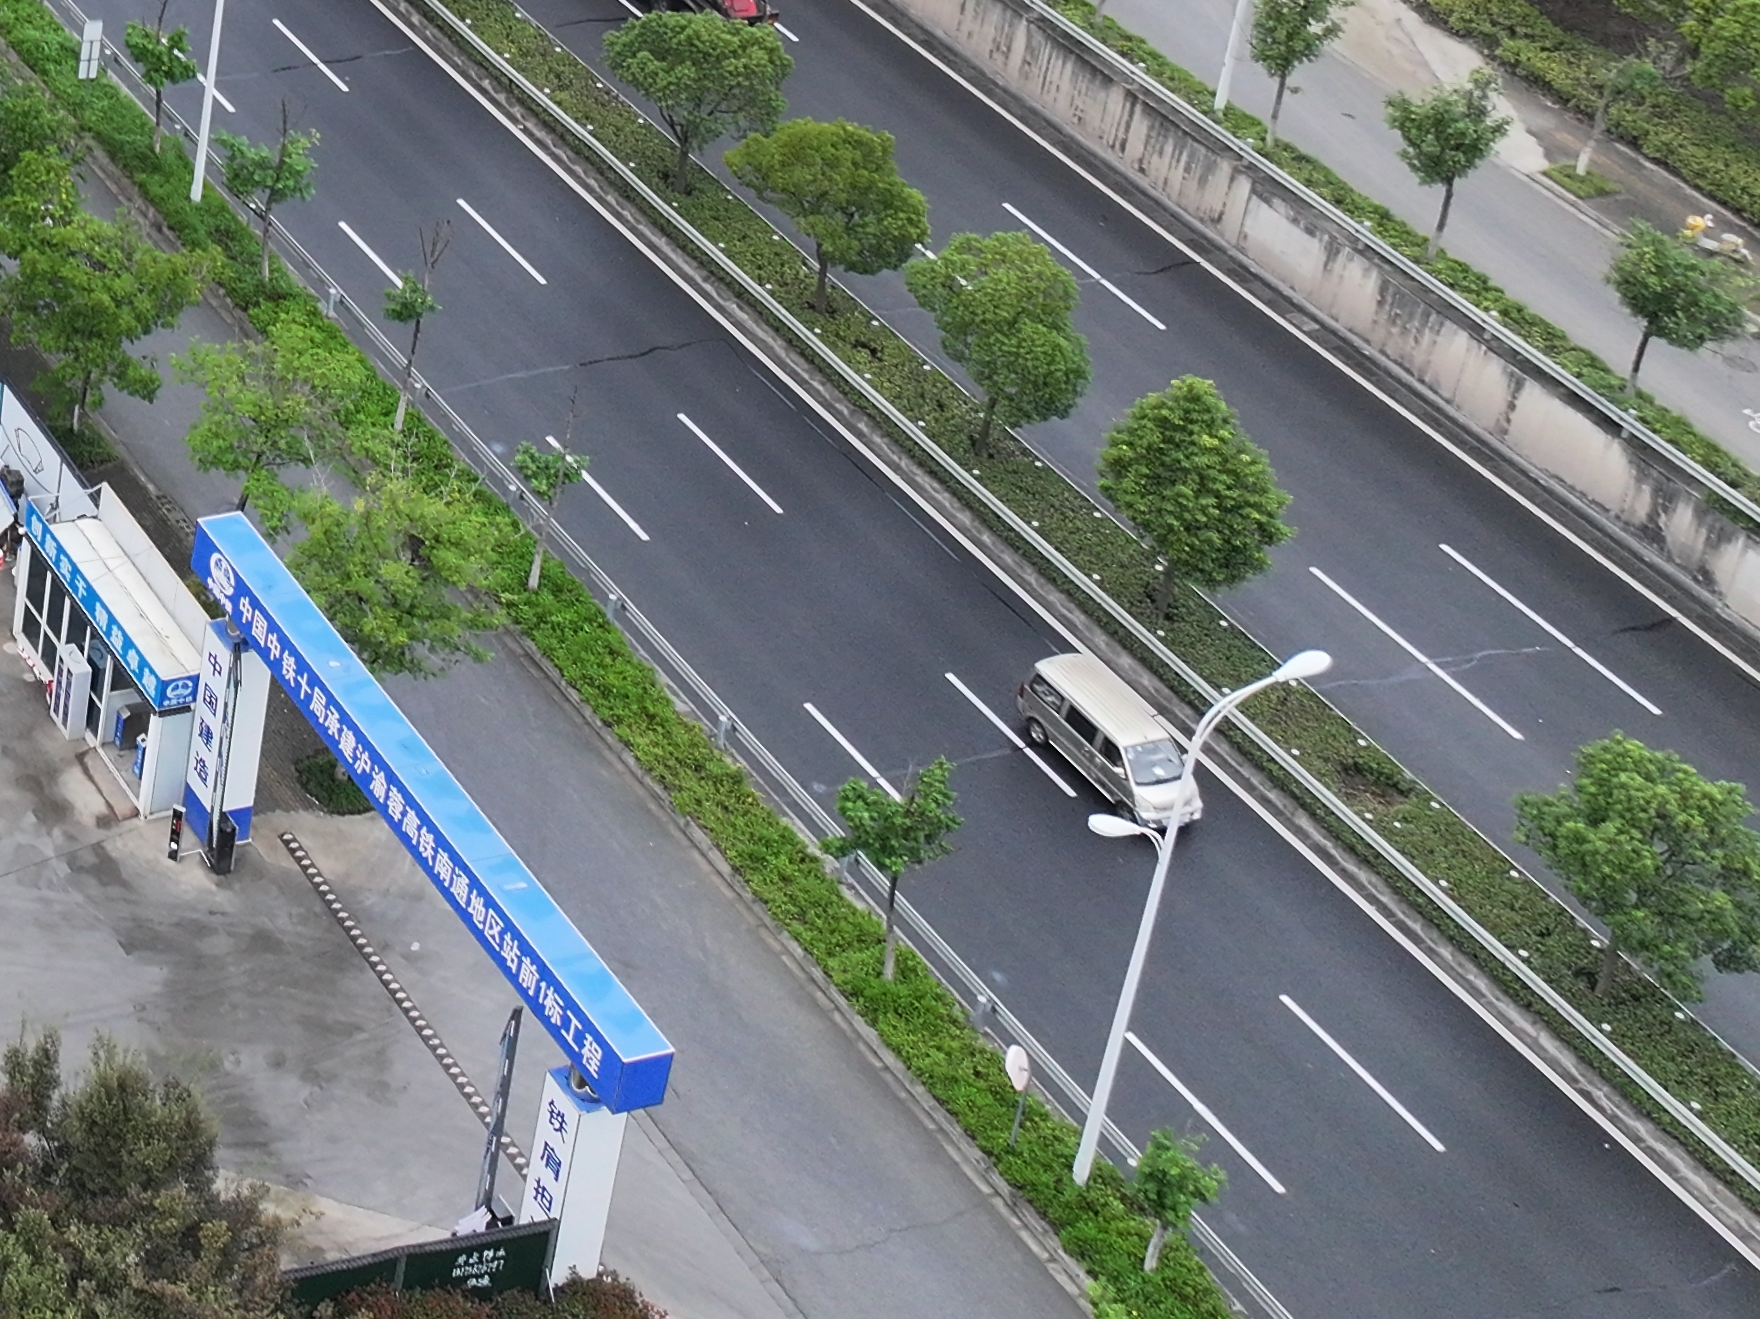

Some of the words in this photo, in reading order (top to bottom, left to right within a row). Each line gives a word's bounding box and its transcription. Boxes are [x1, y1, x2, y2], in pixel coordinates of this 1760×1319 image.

[31, 514, 87, 598] 创新实干
[95, 601, 157, 699] 精益卓越
[193, 650, 223, 789] 中国建造
[239, 595, 603, 1080] 中国中铁十局承建沪渝蓉高铁南通地区站前1标工程
[531, 1098, 569, 1222] 铁肩担
